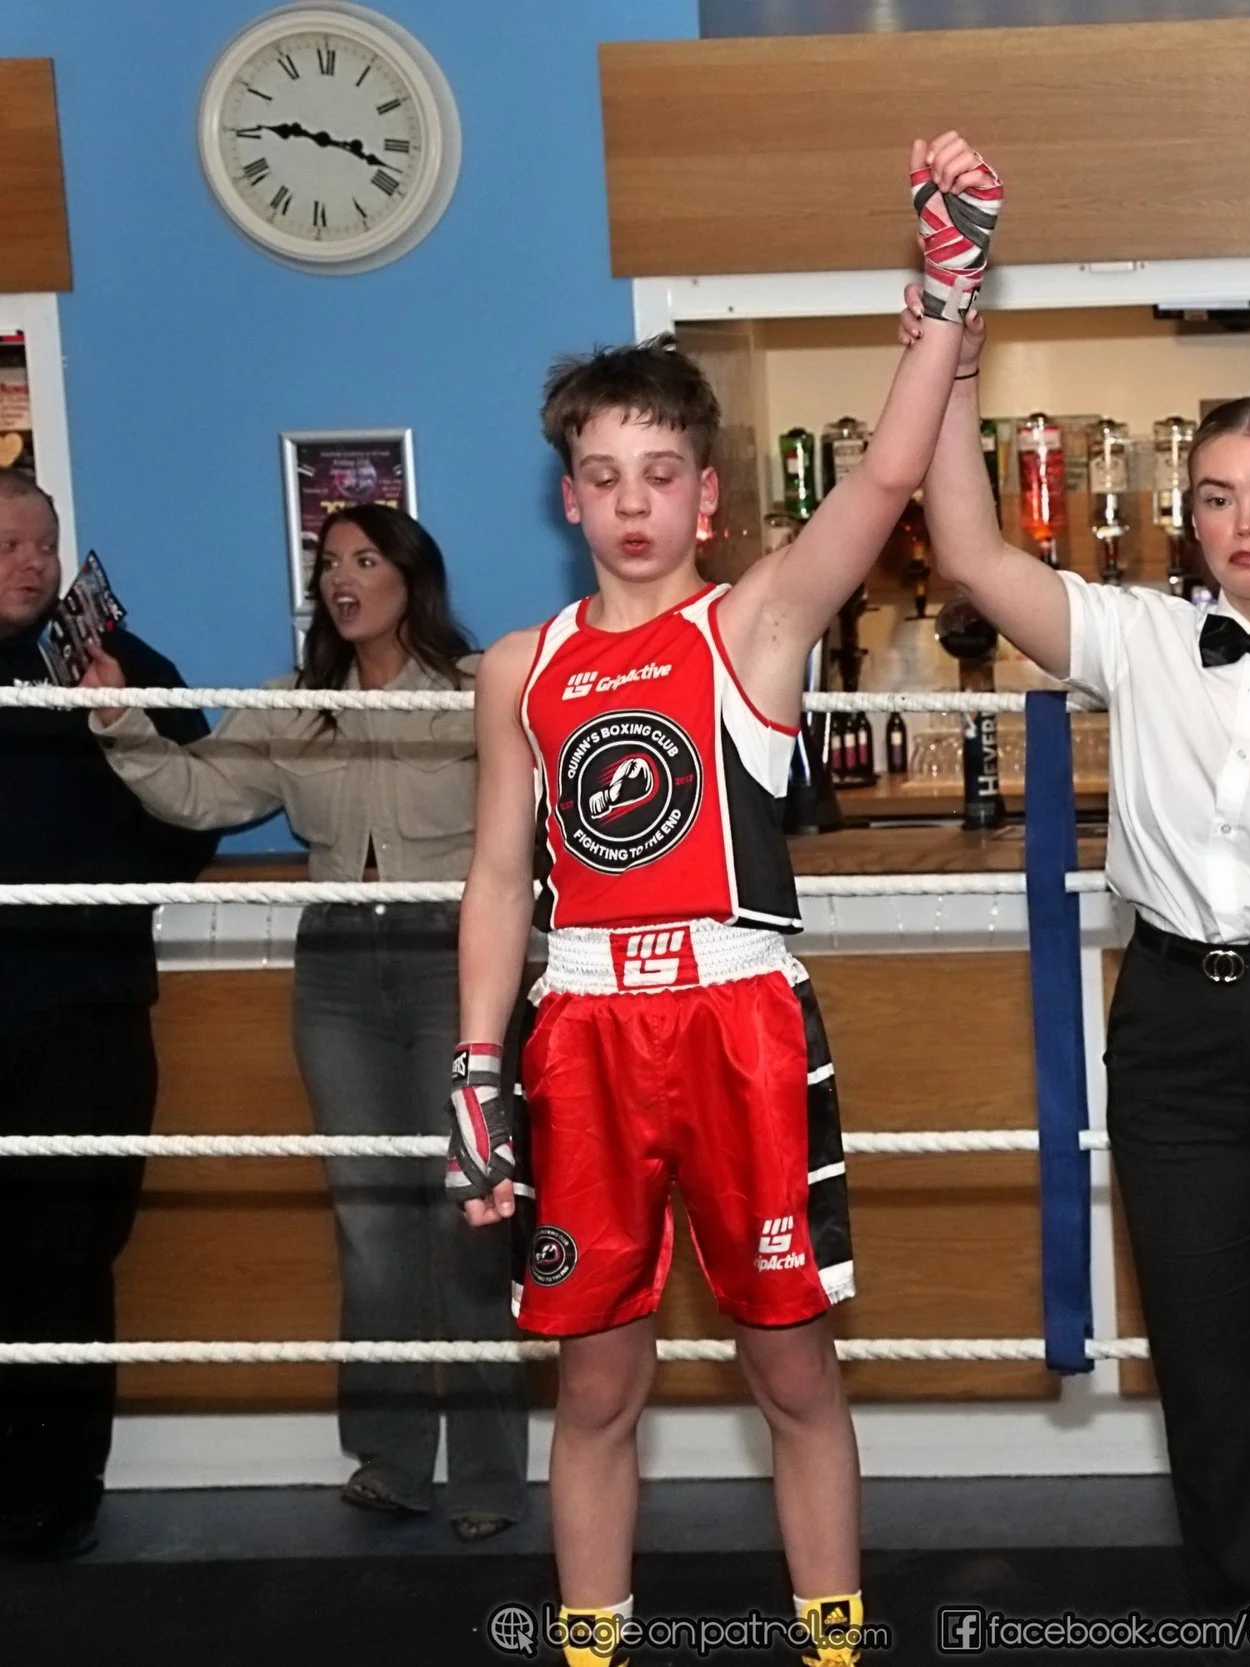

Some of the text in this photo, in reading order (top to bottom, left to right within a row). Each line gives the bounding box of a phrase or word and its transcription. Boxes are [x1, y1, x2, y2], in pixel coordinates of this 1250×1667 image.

[595, 662, 672, 692] GripActive
[567, 723, 679, 779] QUINN'S BOXING CLUB
[573, 808, 682, 861] FIGHTING TO THE END
